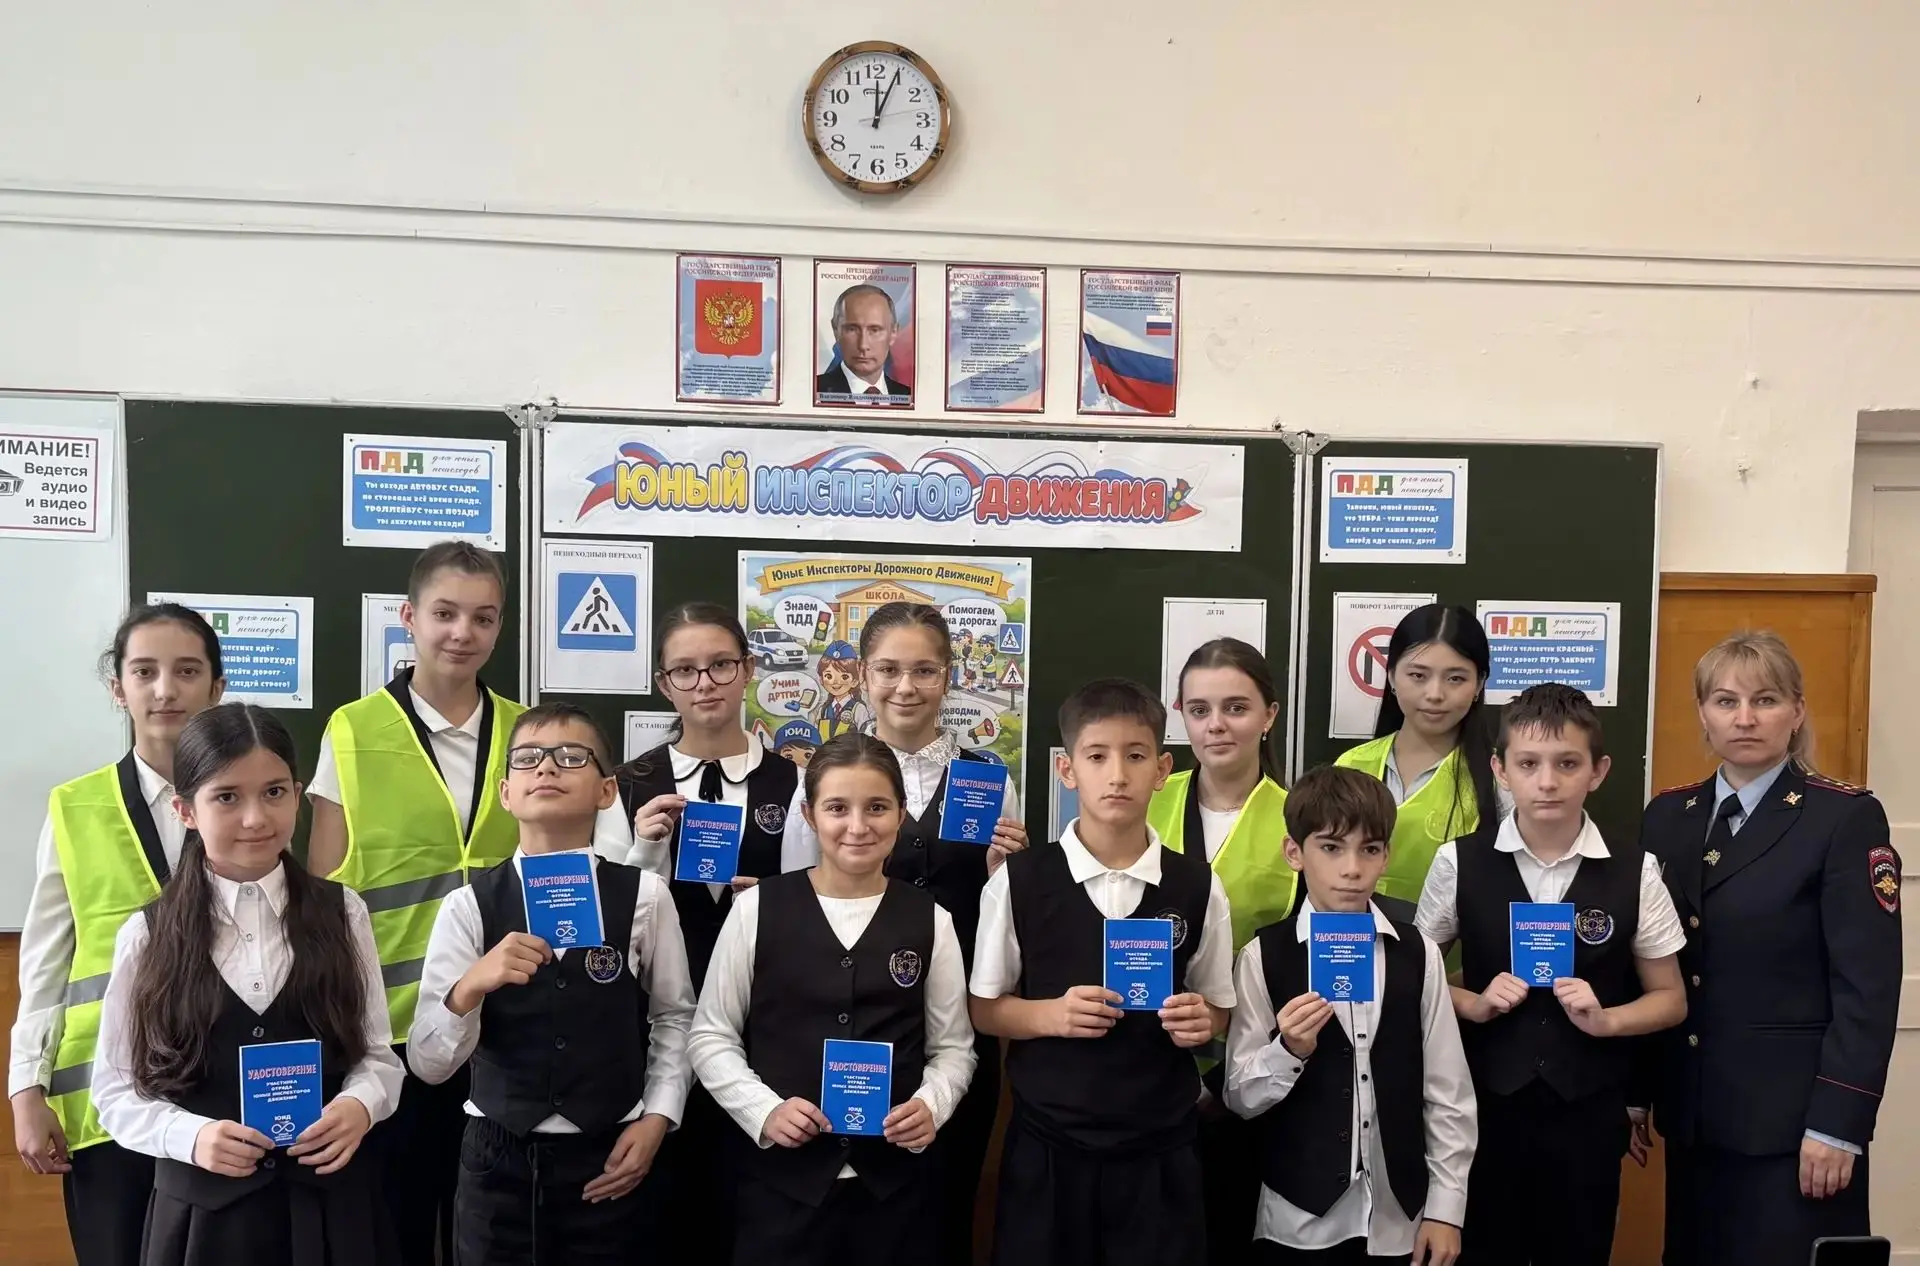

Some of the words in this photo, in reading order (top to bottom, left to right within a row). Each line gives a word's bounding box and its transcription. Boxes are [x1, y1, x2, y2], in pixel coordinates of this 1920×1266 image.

[846, 70, 861, 85] 11
[864, 63, 886, 79] 12
[828, 88, 849, 104] 10
[908, 87, 921, 103] 2
[823, 111, 838, 127] 9
[916, 112, 931, 129] 3
[831, 134, 846, 152] 8
[910, 135, 924, 151] 4
[848, 154, 861, 170] 7
[870, 158, 885, 175] 6
[894, 153, 908, 169] 5
[24, 462, 88, 477] Ведется
[361, 450, 424, 475] ПДД
[41, 482, 88, 494] аудио
[410, 483, 447, 491] АВТОБУС
[614, 450, 750, 513] ЮНЫЙ
[755, 465, 972, 519] ИНСПЕКТОР
[975, 474, 1171, 524] ДВИЖЕНИЯ
[1337, 474, 1394, 496] ПДД
[25, 498, 35, 508] и
[40, 498, 87, 511] видео
[365, 505, 423, 514] ТРОЛЛЕЙБУС
[446, 508, 480, 517] ПОЗАДИ
[33, 514, 87, 526] запись
[553, 550, 607, 558] ПЕШЕХОДНЫЙ
[609, 552, 642, 560] ПЕРЕХОД
[772, 569, 804, 581] Юные
[806, 564, 872, 578] Инспекторы
[874, 563, 933, 577] Дорожного
[935, 567, 995, 587] Движения!
[865, 590, 905, 601] ШКОЛА
[784, 601, 818, 612] Знаем
[948, 604, 995, 616] Помогаем
[786, 613, 814, 627] ПДД
[946, 617, 959, 626] на
[959, 617, 997, 627] дорогах
[1491, 616, 1547, 637] ПДД
[252, 656, 296, 665] ПЕРЕХОД!
[770, 679, 800, 690] Учим
[785, 728, 811, 738] ЮИД
[952, 777, 1002, 791] УДОСТОВЕРЕНИЕ
[686, 819, 738, 832] УДОСТОВЕРЕНИЕ
[528, 875, 590, 887] УДОСТОВЕРЕНИЕ
[1515, 921, 1571, 931] УДОСТОВЕРЕНИЕ
[1109, 939, 1169, 950] УДОСТОВЕРЕНИЕ
[1314, 933, 1371, 942] УДОСТОВЕРЕНИЕ
[248, 1064, 316, 1080] УДОСТОВЕРЕНИЕ
[828, 1061, 887, 1074] УДОСТОВЕРЕНИЕ
